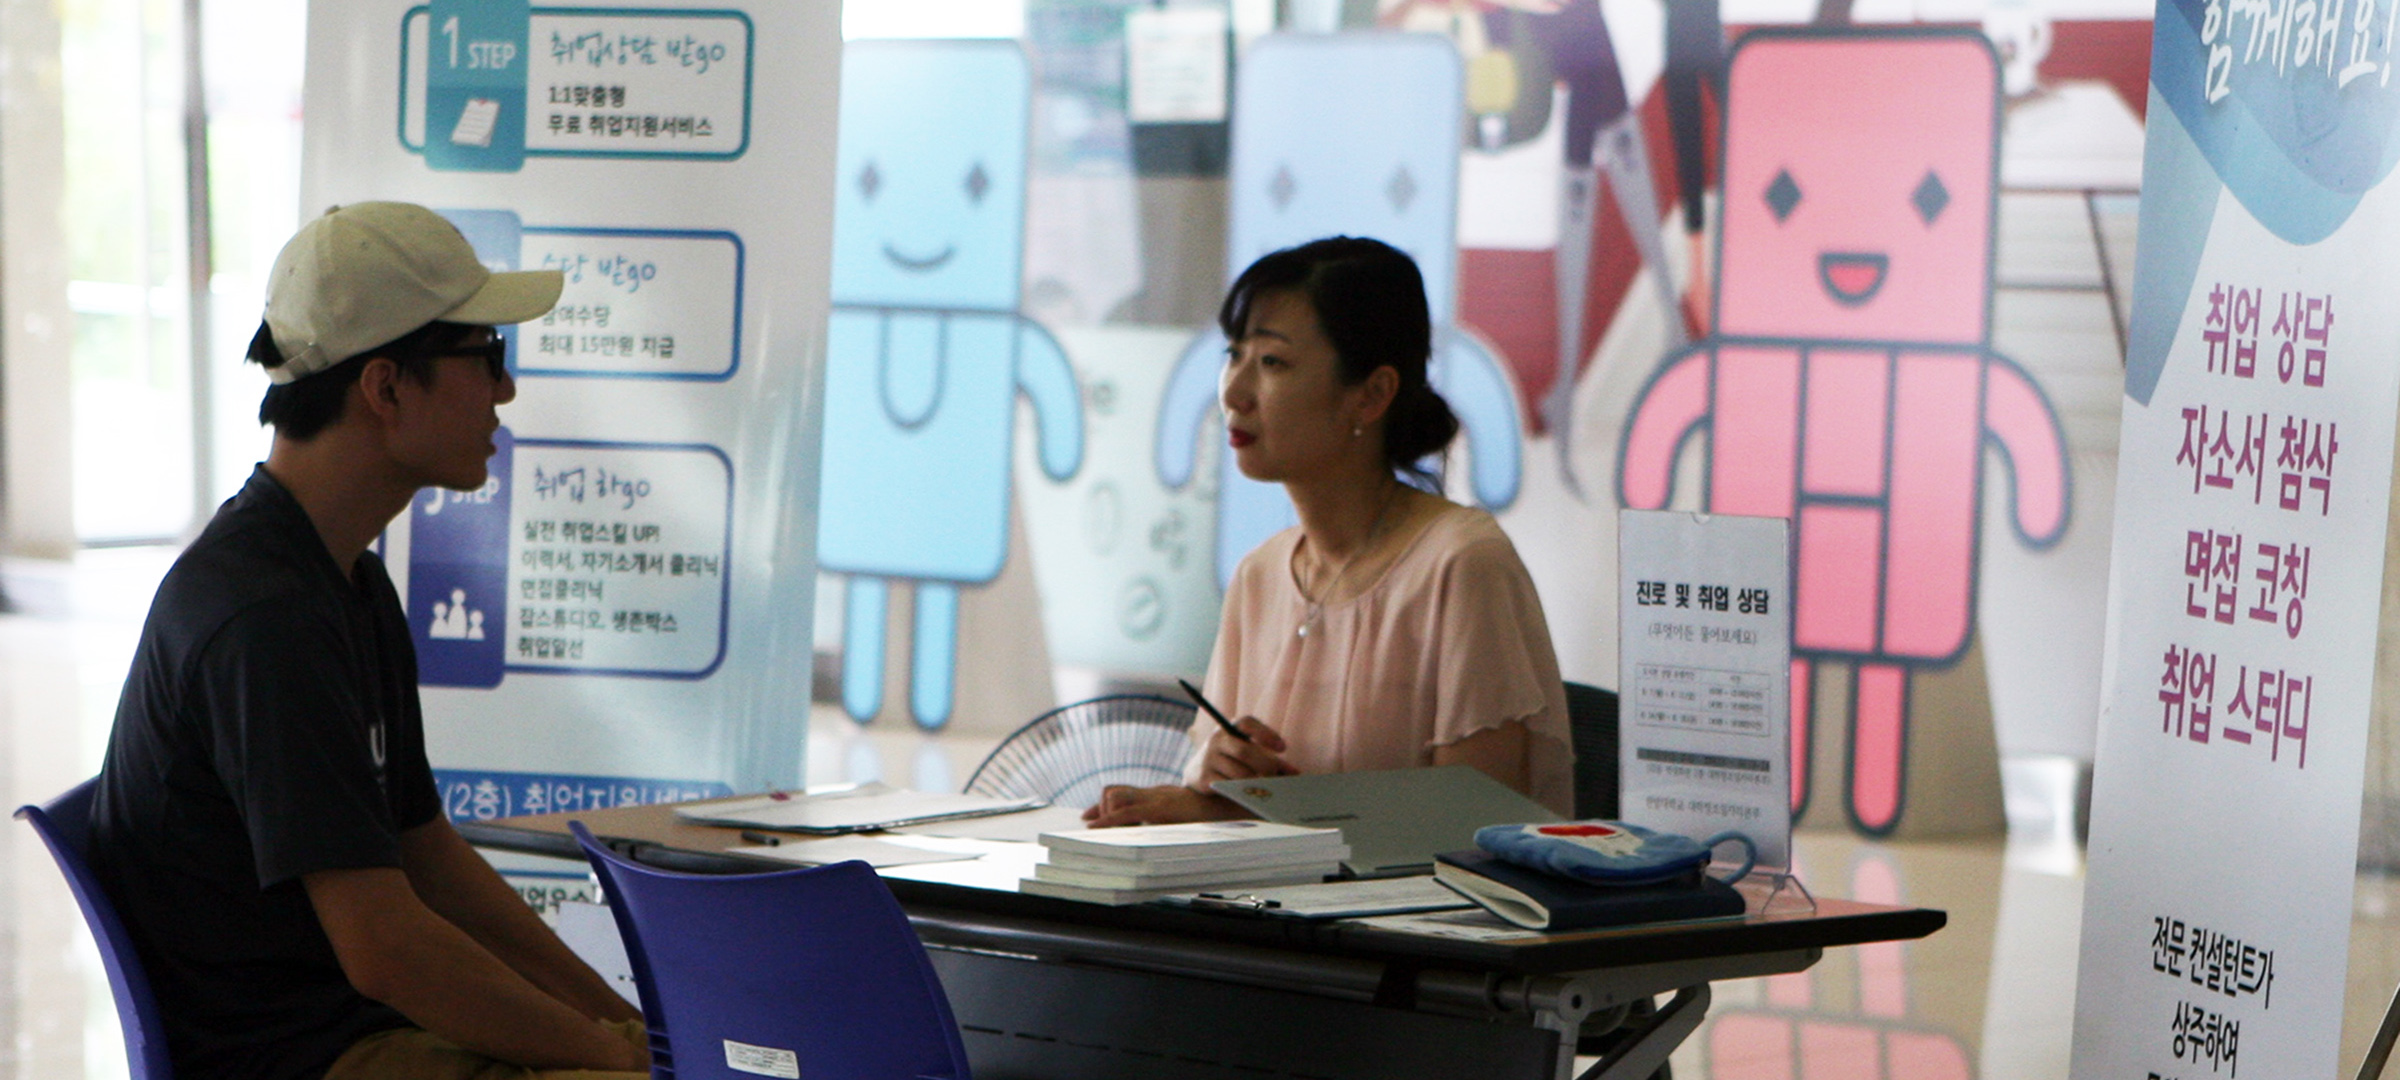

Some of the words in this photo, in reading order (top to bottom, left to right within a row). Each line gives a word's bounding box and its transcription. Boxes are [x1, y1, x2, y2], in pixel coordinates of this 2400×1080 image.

[442, 16, 459, 69] 1
[468, 41, 516, 69] STEP
[551, 31, 657, 67] 취업상담
[549, 85, 626, 108] 1:1맞춤형
[549, 114, 580, 135] 무료
[589, 114, 713, 138] 취업지원서비스
[539, 334, 573, 355] 최대
[581, 335, 634, 357] 15만원
[641, 336, 675, 358] 지급
[2202, 282, 2262, 379] 취업
[2271, 291, 2334, 388] 상담
[2176, 404, 2268, 505] 자소서
[2277, 415, 2338, 517] 첨삭
[535, 465, 585, 504] 취업
[525, 521, 555, 542] 실전
[562, 521, 627, 544] 취업스킬
[581, 551, 664, 575] 자기소개서
[670, 553, 718, 577] 클리닉
[520, 579, 603, 601] 면접클리닉
[1636, 581, 1666, 606] 진로
[1675, 583, 1690, 608] 및
[1697, 584, 1730, 612] 취업
[1737, 587, 1769, 615] 상담
[2184, 529, 2242, 625] 면접
[2249, 543, 2311, 640] 코칭
[612, 610, 678, 633] 생존박스
[518, 636, 583, 660] 취업알선
[2158, 643, 2217, 744] 취업
[2223, 665, 2313, 770] 스터디
[2152, 916, 2186, 978] 전문
[2190, 927, 2274, 1010] 컨설턴트가
[2171, 1000, 2240, 1079] 상주하여
